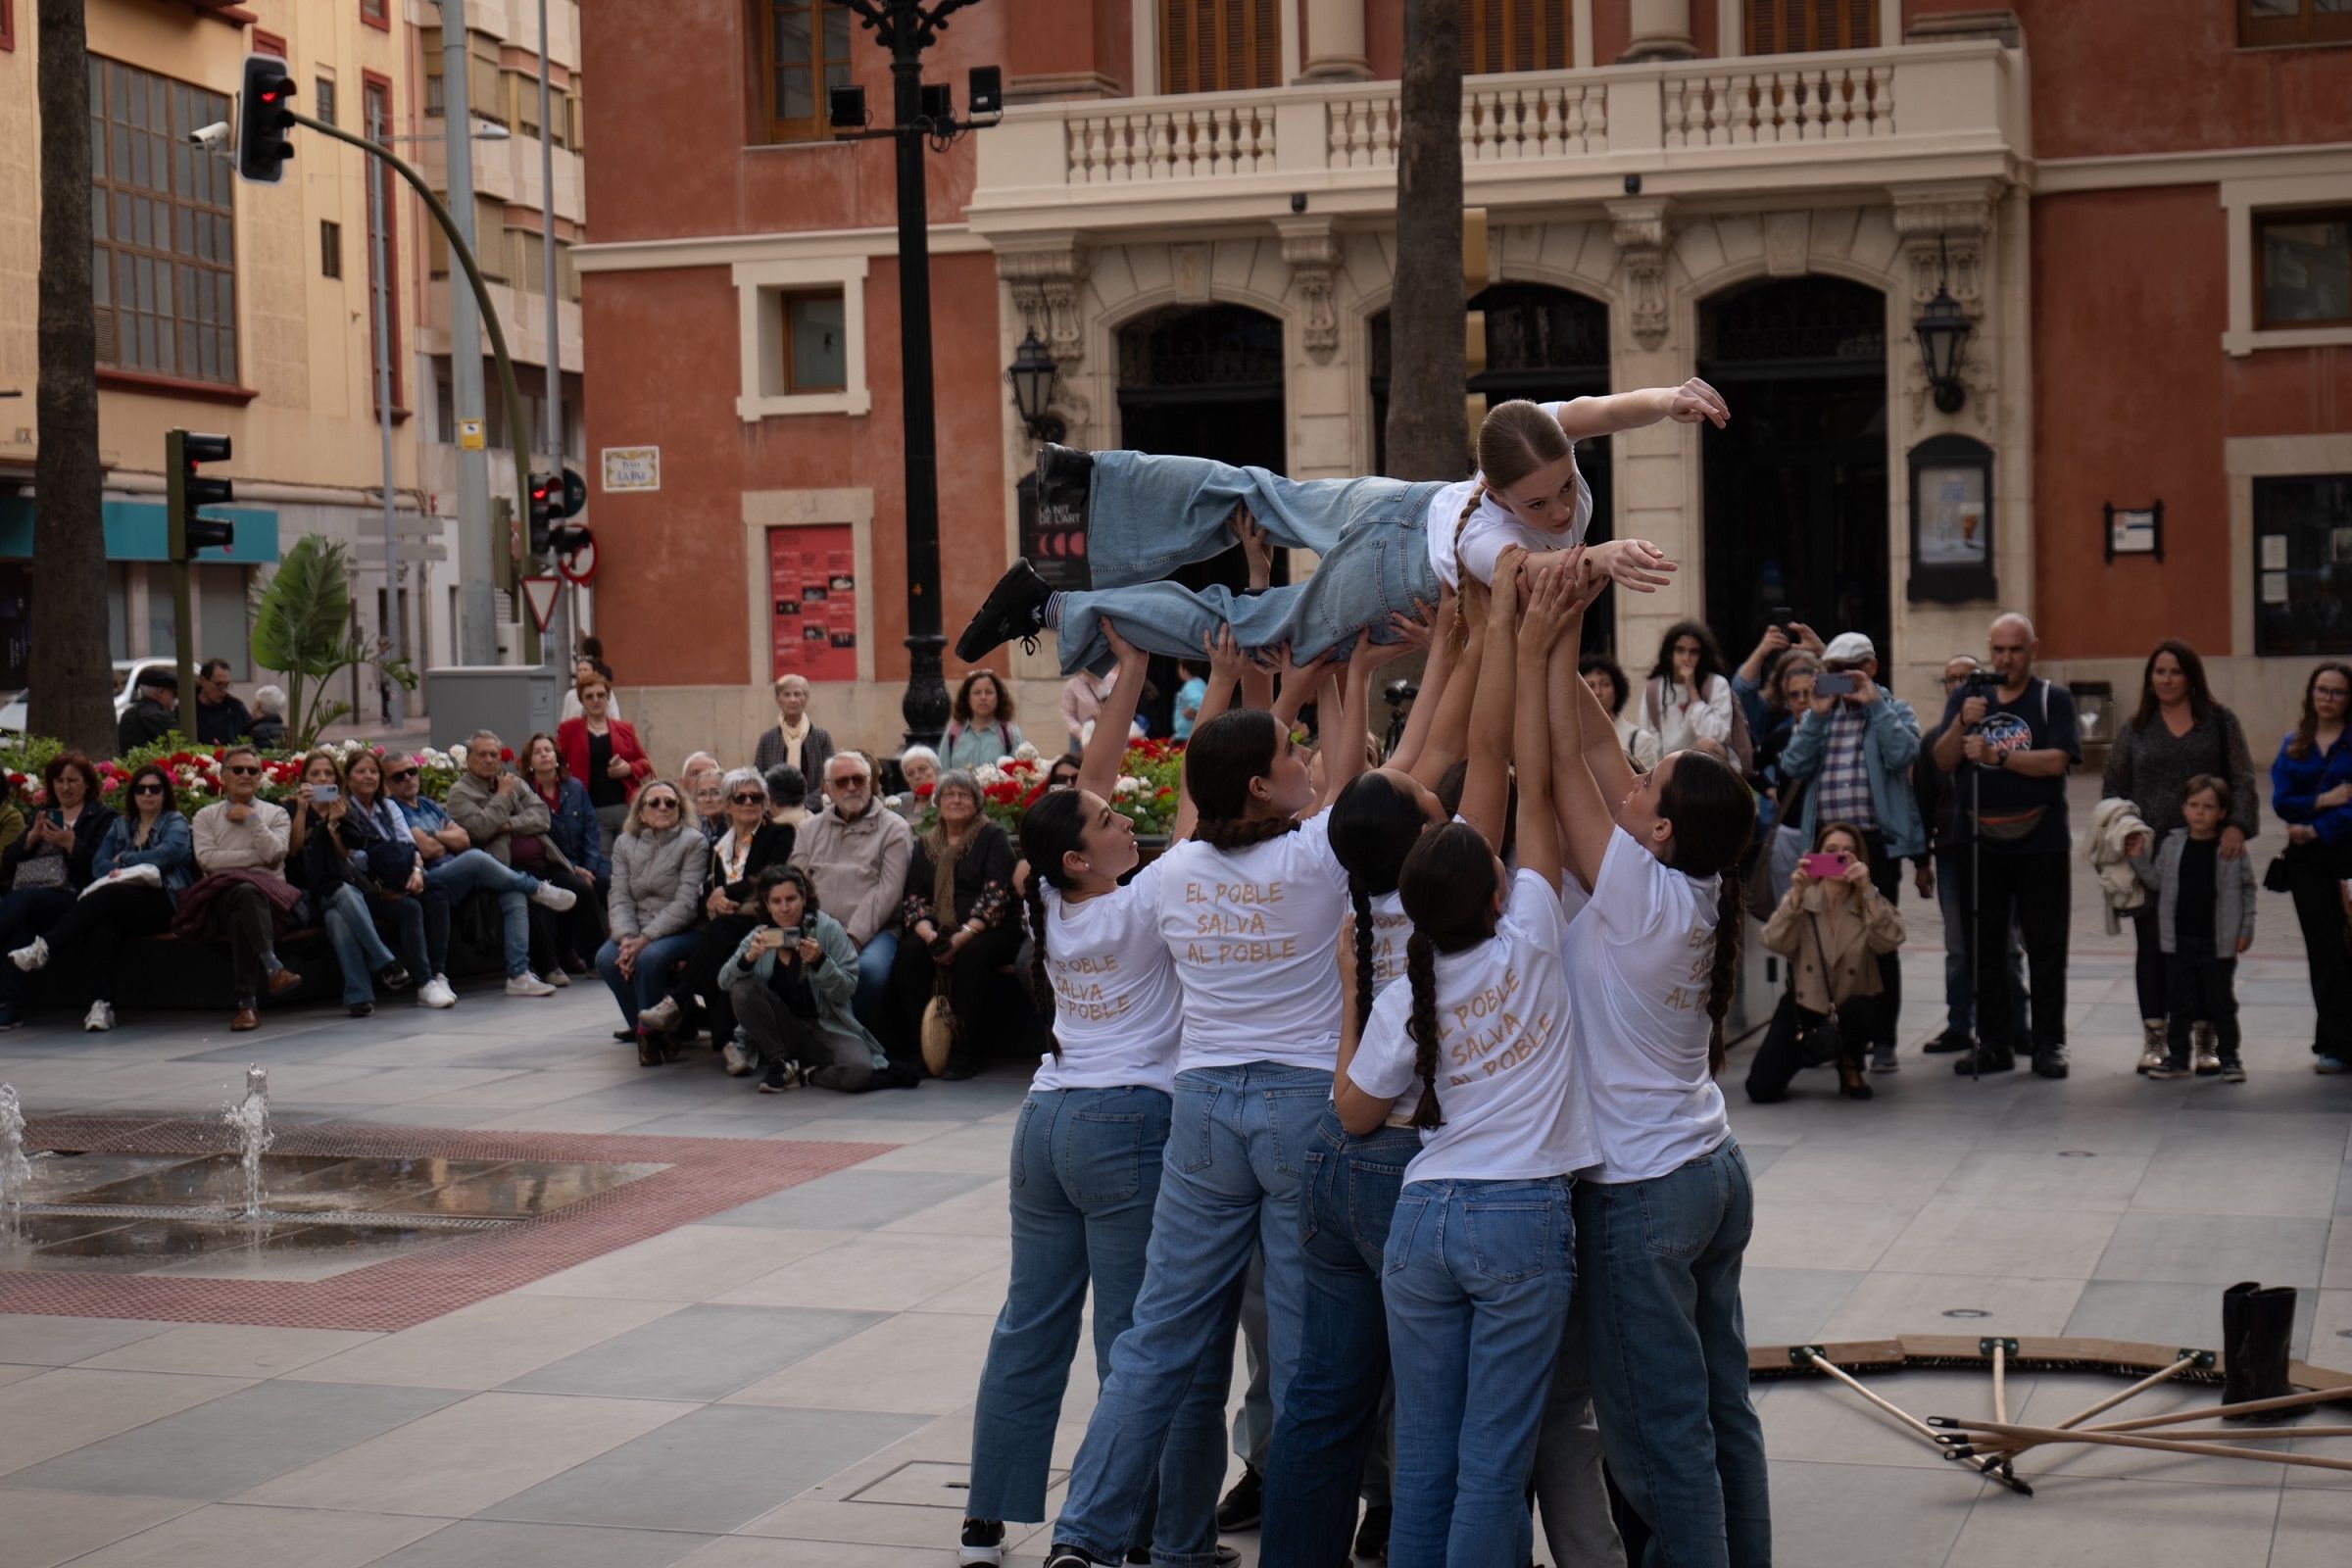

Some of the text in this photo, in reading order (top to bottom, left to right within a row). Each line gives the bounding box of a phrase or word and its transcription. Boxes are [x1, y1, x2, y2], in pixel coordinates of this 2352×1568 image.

[1039, 504, 1070, 514] LA NIT
[1039, 514, 1052, 525] DE
[1976, 726, 2014, 738] ACK
[1186, 881, 1284, 906] EL POBLE
[1198, 912, 1266, 937] SALVA
[1188, 939, 1297, 965] AL POBLE
[1067, 995, 1130, 1021] POBLE
[1453, 967, 1521, 1030] POBLE
[1663, 987, 1691, 1012] AL
[1451, 1012, 1524, 1067] SALVA
[1482, 1012, 1554, 1077] POBLE
